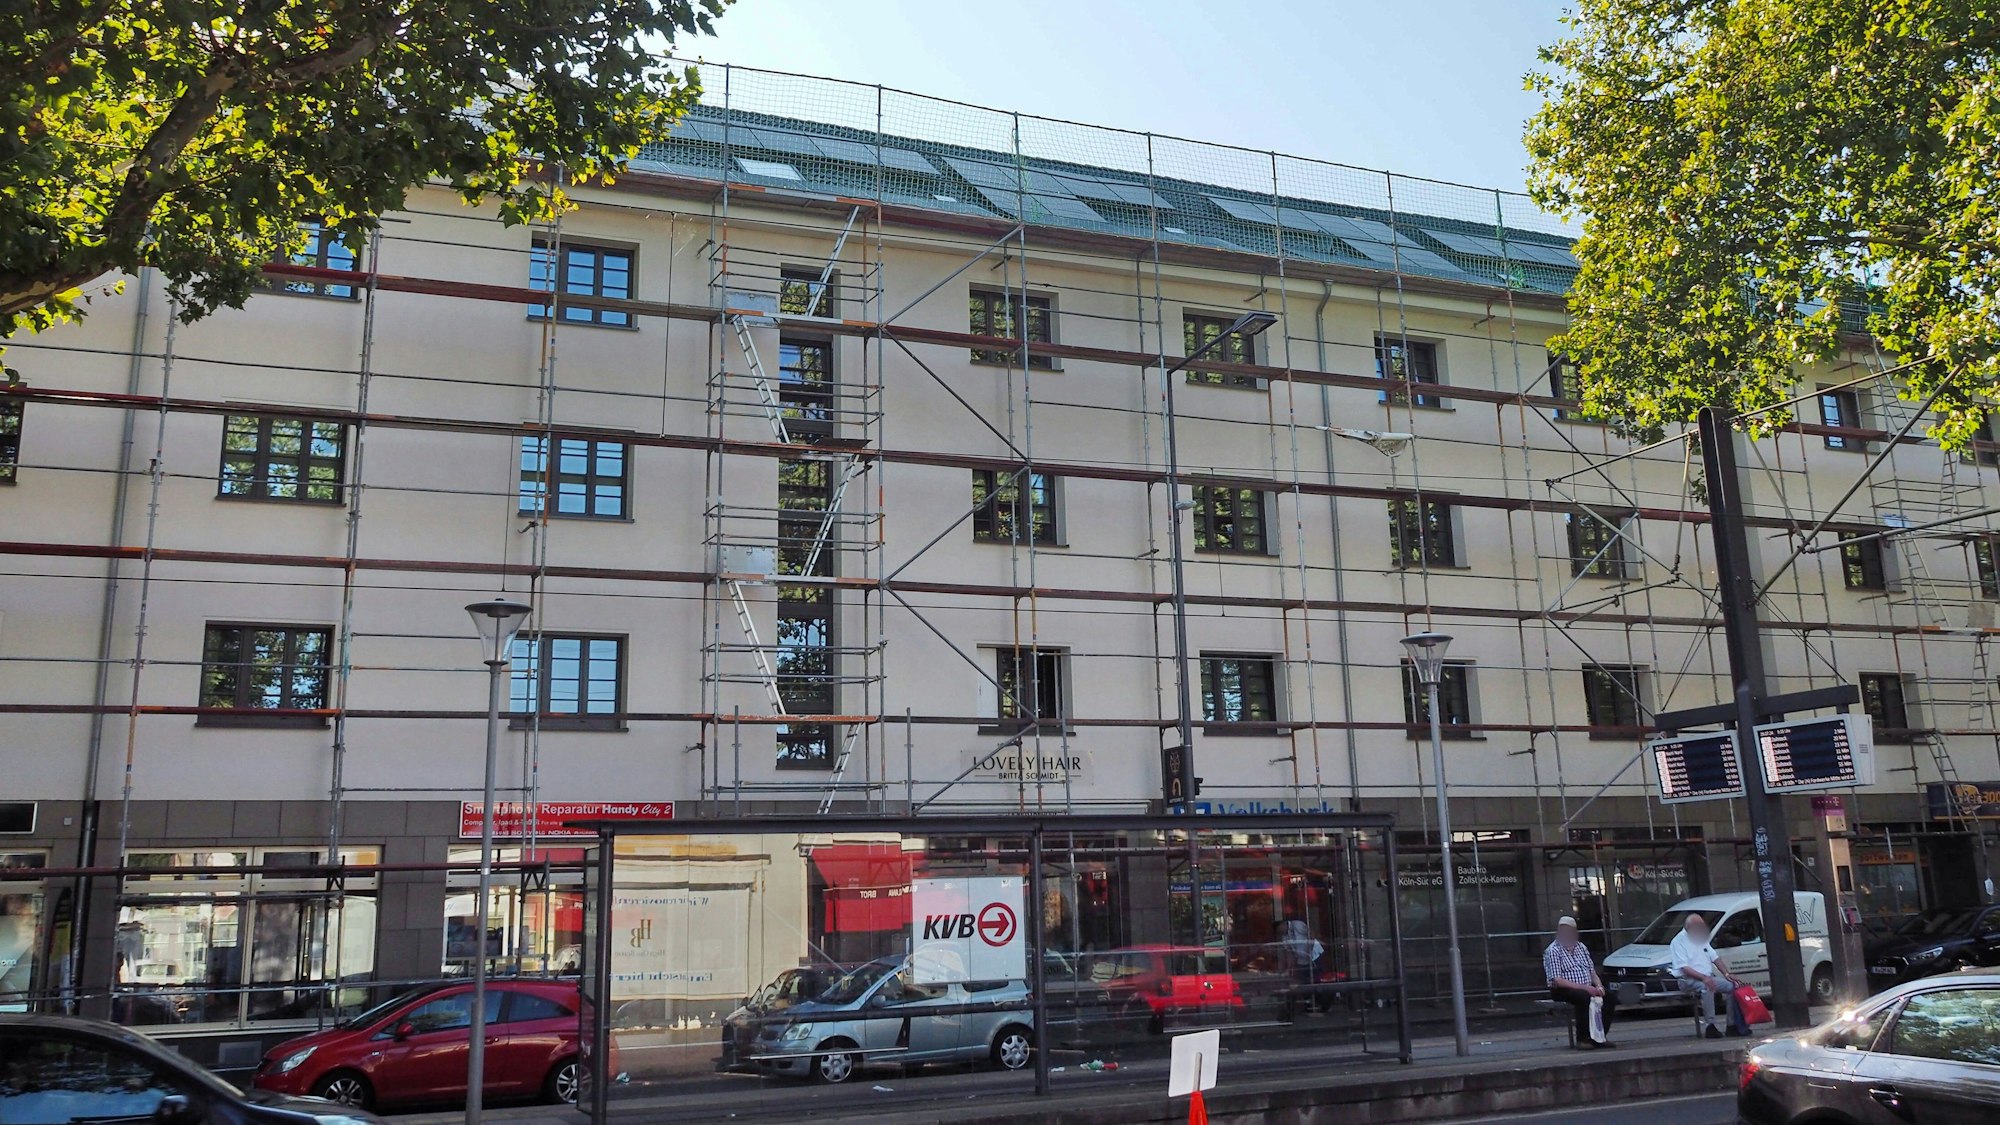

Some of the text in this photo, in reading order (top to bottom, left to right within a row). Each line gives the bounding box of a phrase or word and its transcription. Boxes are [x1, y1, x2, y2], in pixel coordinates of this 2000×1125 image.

[1043, 756, 1081, 770] HAIR
[464, 803, 671, 816] Smrtphone Reparatur Handy City 2
[1457, 865, 1487, 875] Baubro
[1432, 876, 1443, 885] eG
[1459, 875, 1517, 885] Zollstck-Karrees
[923, 914, 976, 939] KVB
